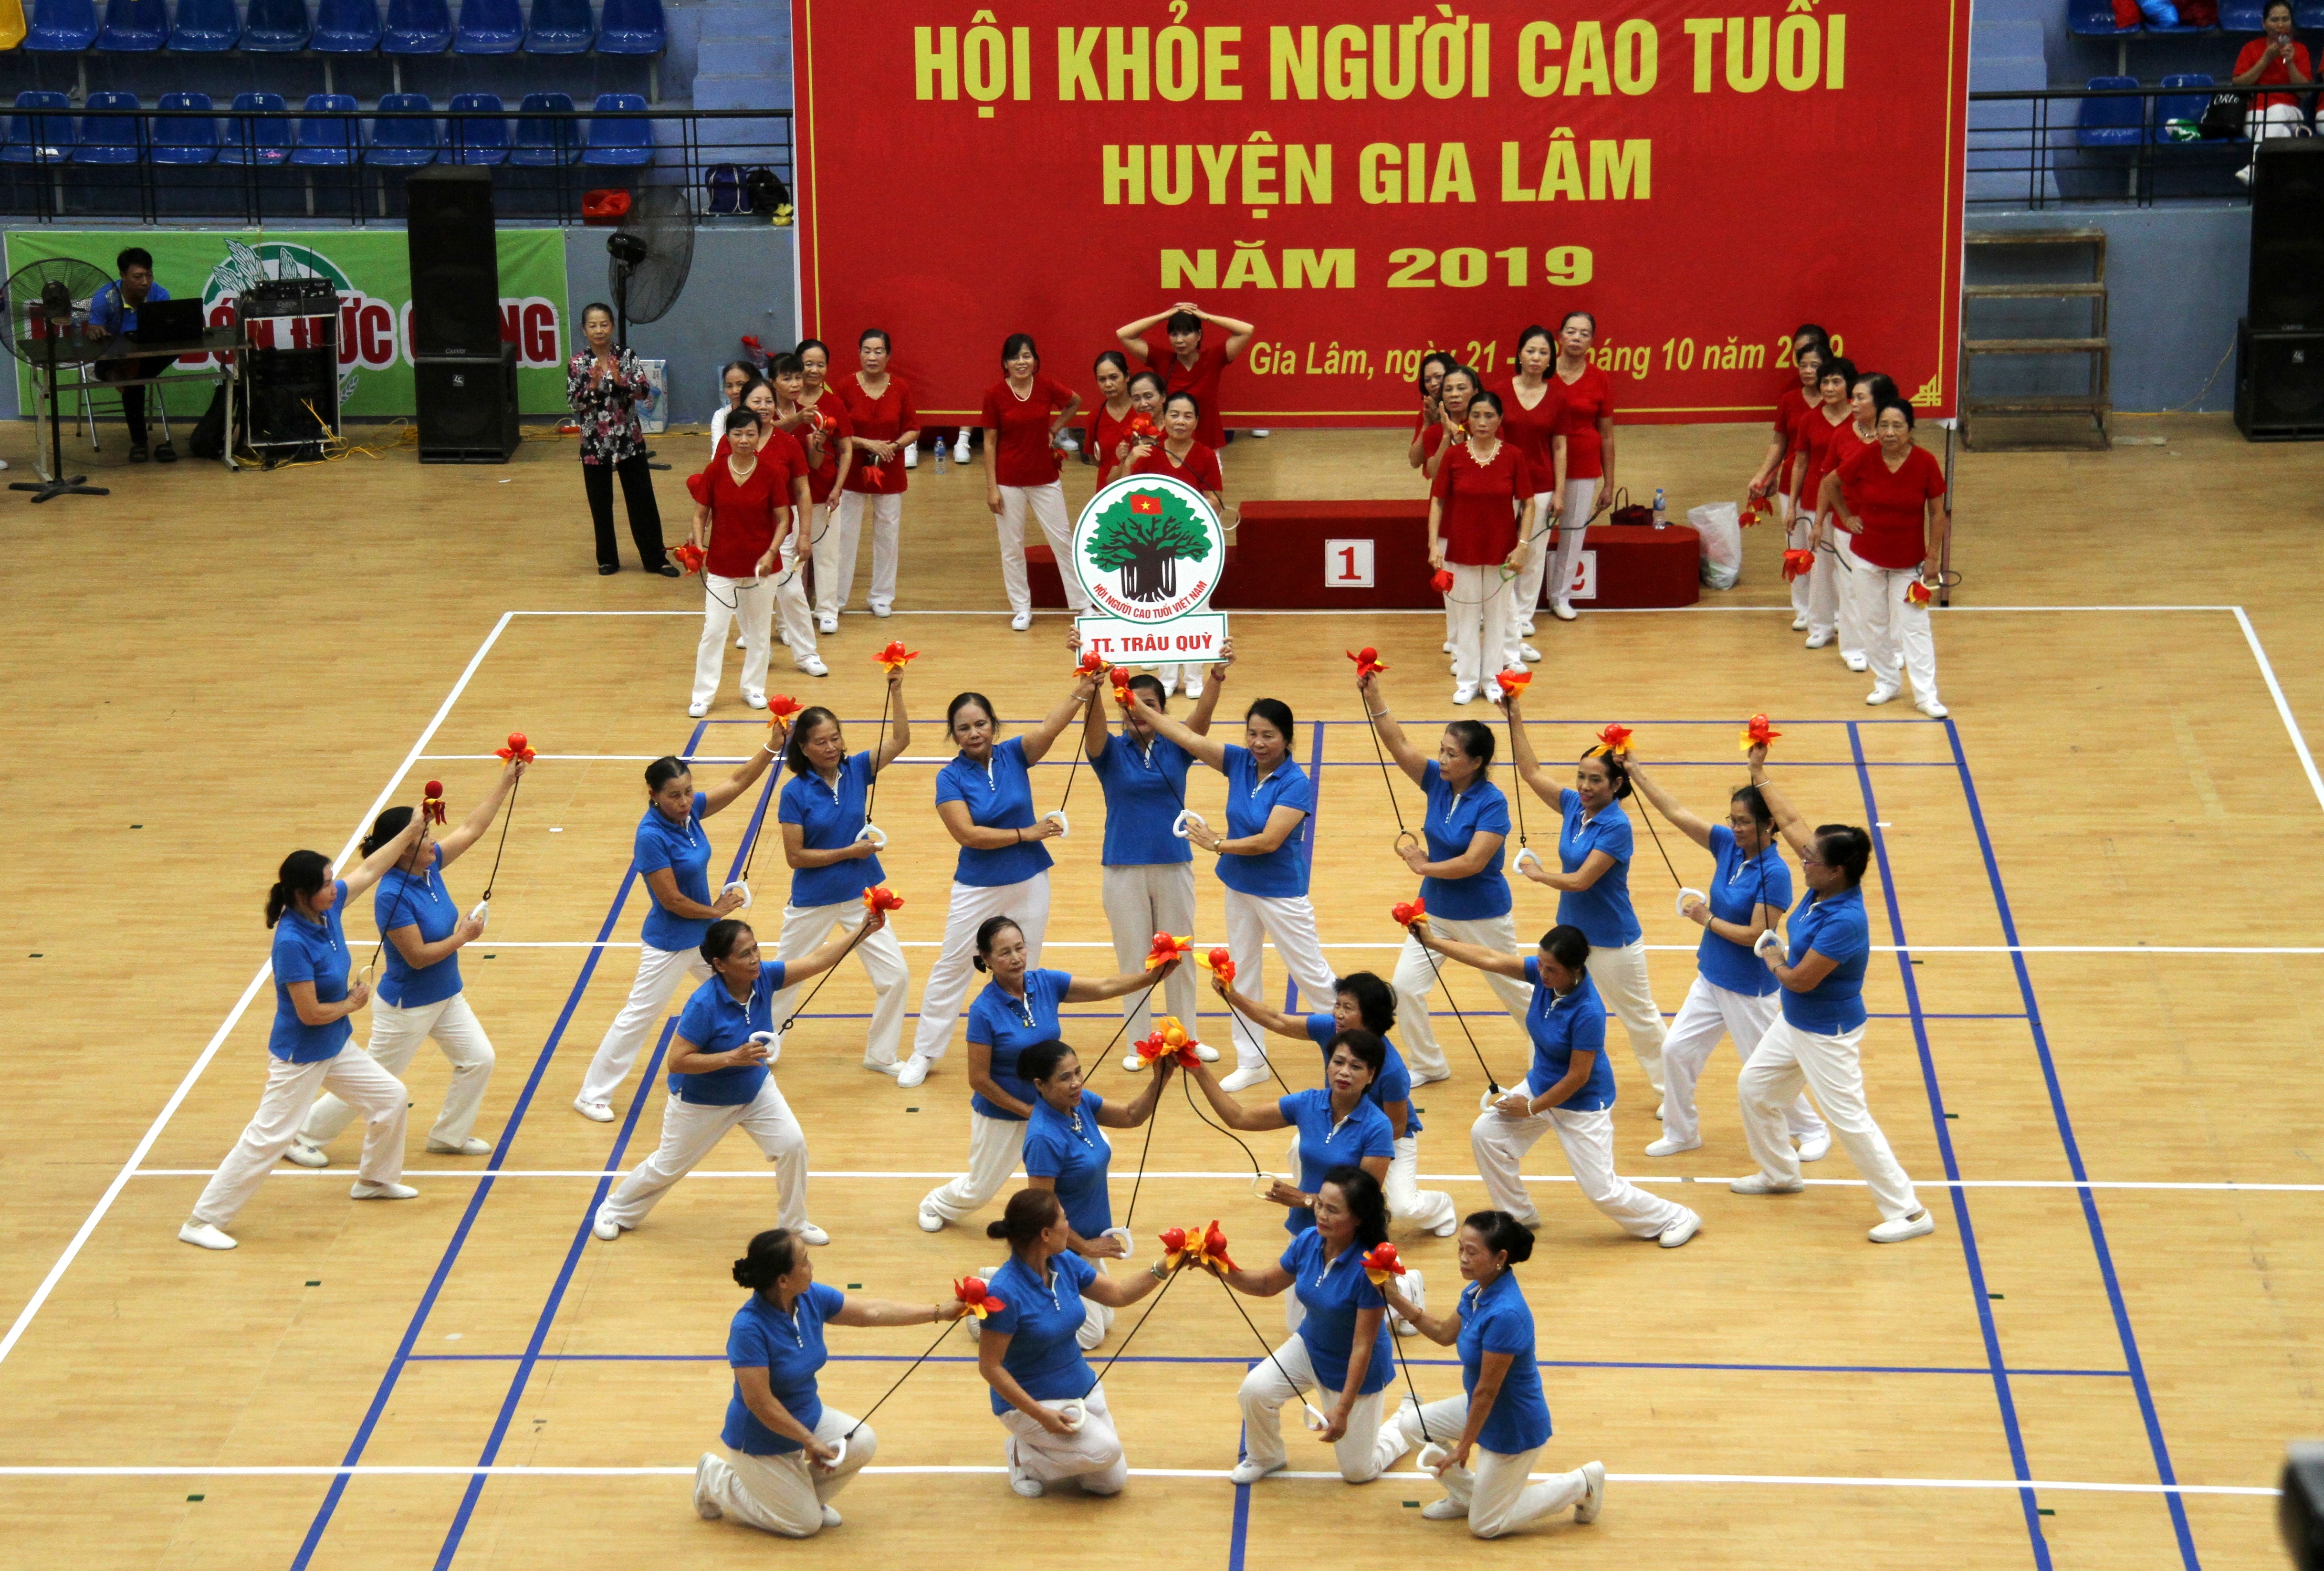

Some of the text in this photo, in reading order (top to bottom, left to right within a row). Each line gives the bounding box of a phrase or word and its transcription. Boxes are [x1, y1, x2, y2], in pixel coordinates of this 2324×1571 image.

[914, 0, 1846, 118] HỘI KHỎE NGƯỜI CAO TUỔI
[1102, 126, 1652, 219] HUYỆN GIA LÂM
[1161, 240, 1593, 289] NĂM 2019
[1249, 342, 1296, 375] Gia
[1306, 341, 1374, 380] Lâm,
[1466, 340, 1496, 373] 21
[1662, 337, 1695, 371] 10
[1702, 336, 1765, 370] năm
[1338, 546, 1361, 580] 1
[1093, 580, 1207, 619] HỘI NGƯỜI CAO TUỔI VIỆT NAM
[1091, 632, 1212, 653] TT. TRÂU QUỲ
